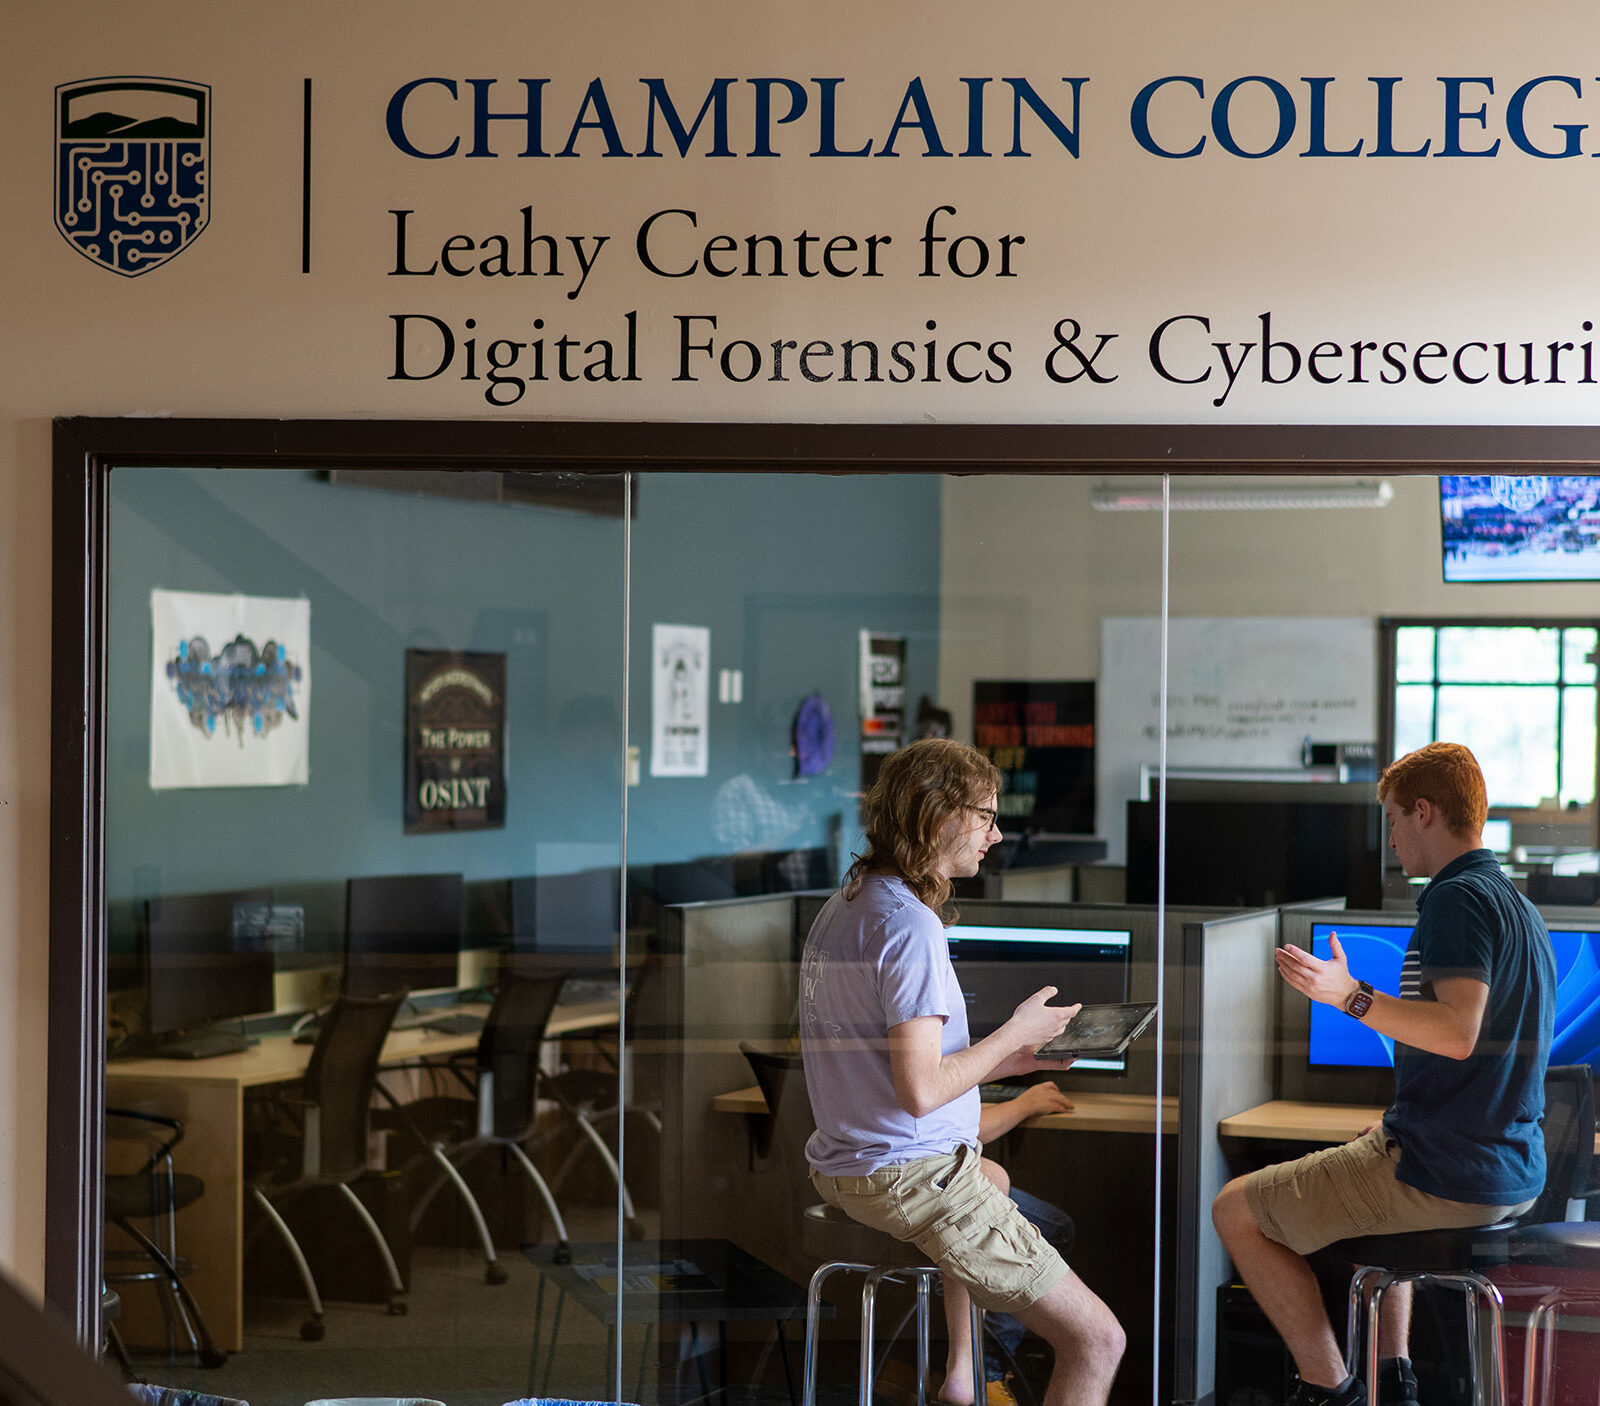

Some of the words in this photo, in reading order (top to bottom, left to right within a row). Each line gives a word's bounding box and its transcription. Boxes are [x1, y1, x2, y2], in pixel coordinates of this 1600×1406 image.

[386, 76, 1090, 159] CHAMPLAIN
[1131, 75, 1600, 159] COLLEG
[388, 205, 610, 300] Leahy
[637, 209, 892, 277] Center
[919, 206, 1025, 277] for
[387, 310, 642, 406] Digital
[672, 315, 1011, 383] Forensics
[1045, 319, 1119, 383] &
[1149, 312, 1598, 407] Cybersecuri
[419, 776, 490, 809] OSINT
